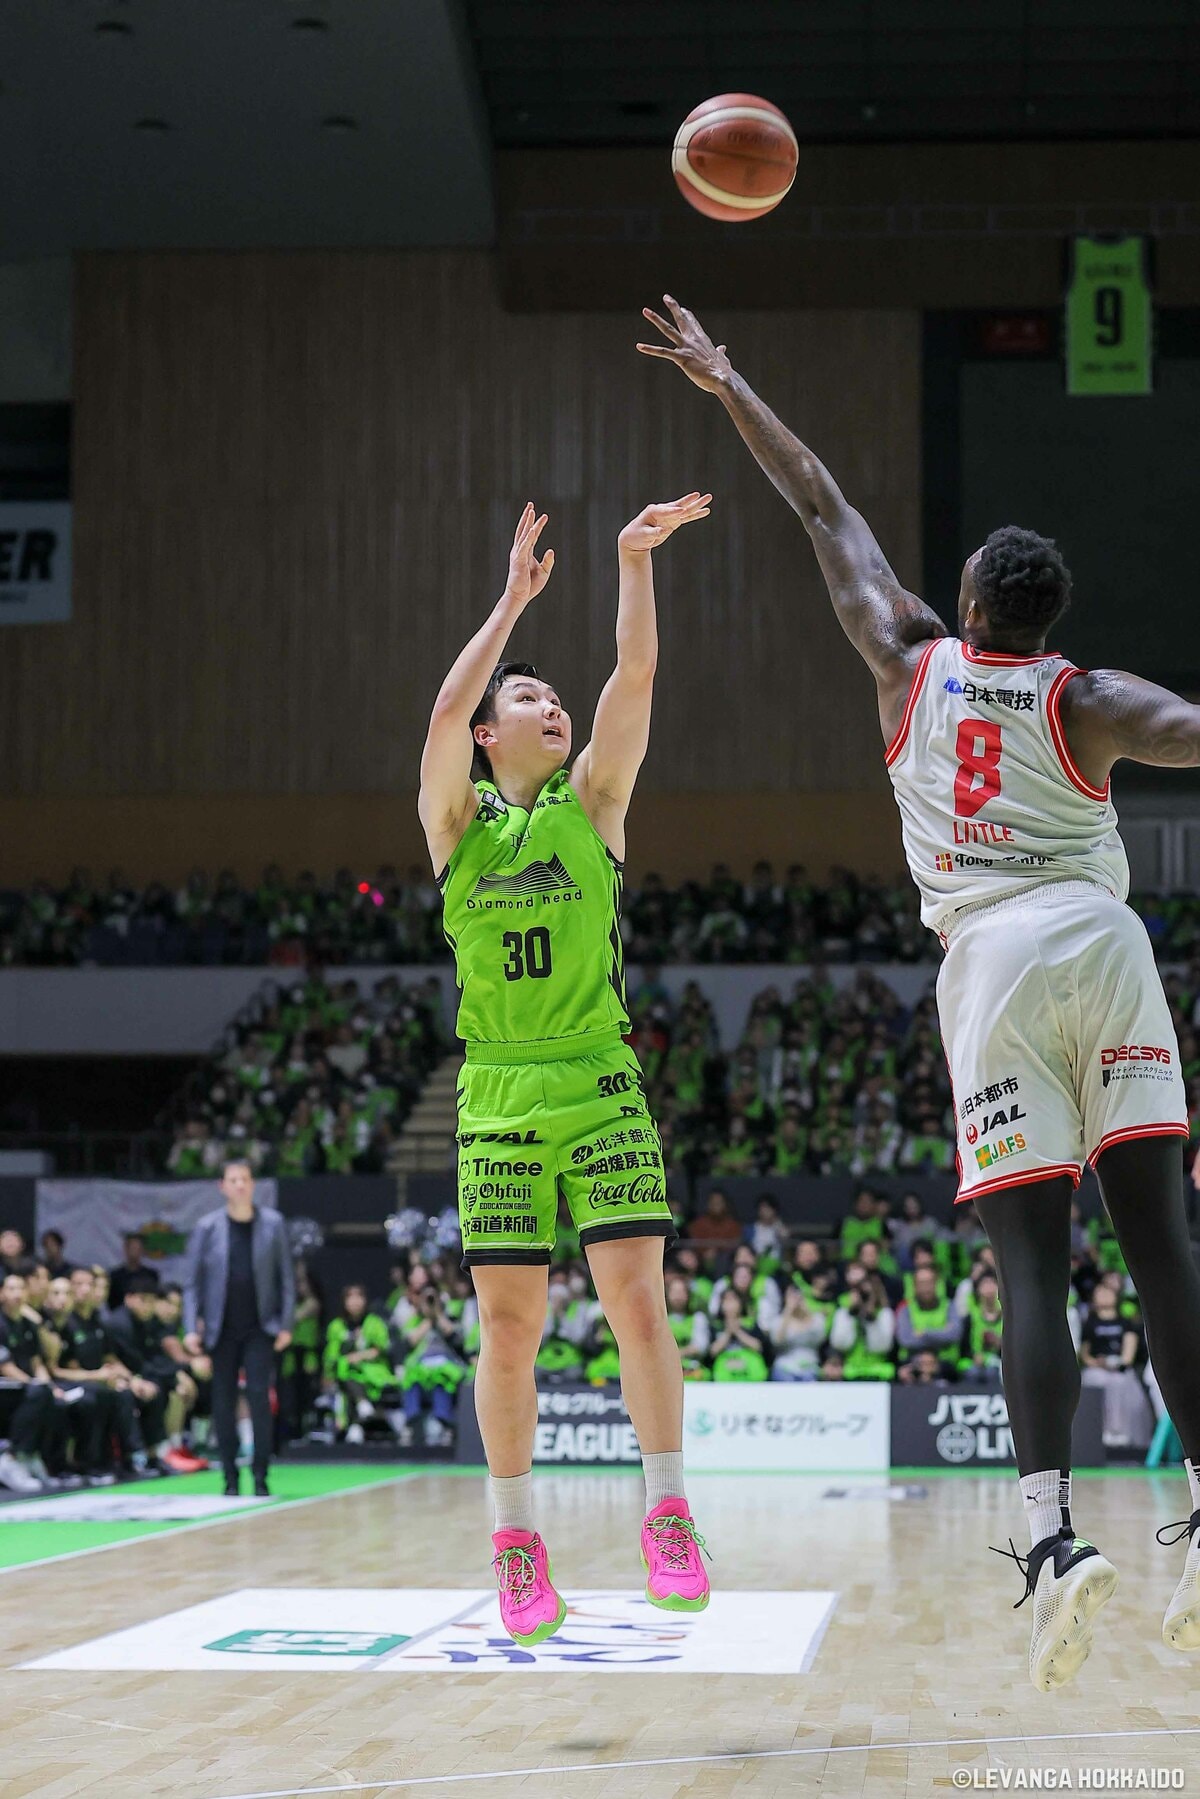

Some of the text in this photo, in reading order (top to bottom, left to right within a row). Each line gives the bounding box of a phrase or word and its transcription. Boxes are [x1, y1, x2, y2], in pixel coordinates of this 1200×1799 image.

[1095, 287, 1121, 346] 9
[963, 682, 1036, 711] 日本電技
[954, 718, 1002, 817] 8
[953, 821, 1015, 844] LITTLE
[466, 889, 583, 910] Diamond head
[502, 926, 553, 982] 30
[597, 1071, 631, 1099] 30
[964, 1077, 1019, 1116] 日本都市
[981, 1104, 1027, 1136] JAL
[594, 1128, 656, 1153] 北洋銀行
[991, 1132, 1027, 1160] JAFS
[472, 1157, 543, 1177] Timee
[479, 1182, 532, 1203] Ohfuji
[532, 1423, 641, 1460] EAGUE
